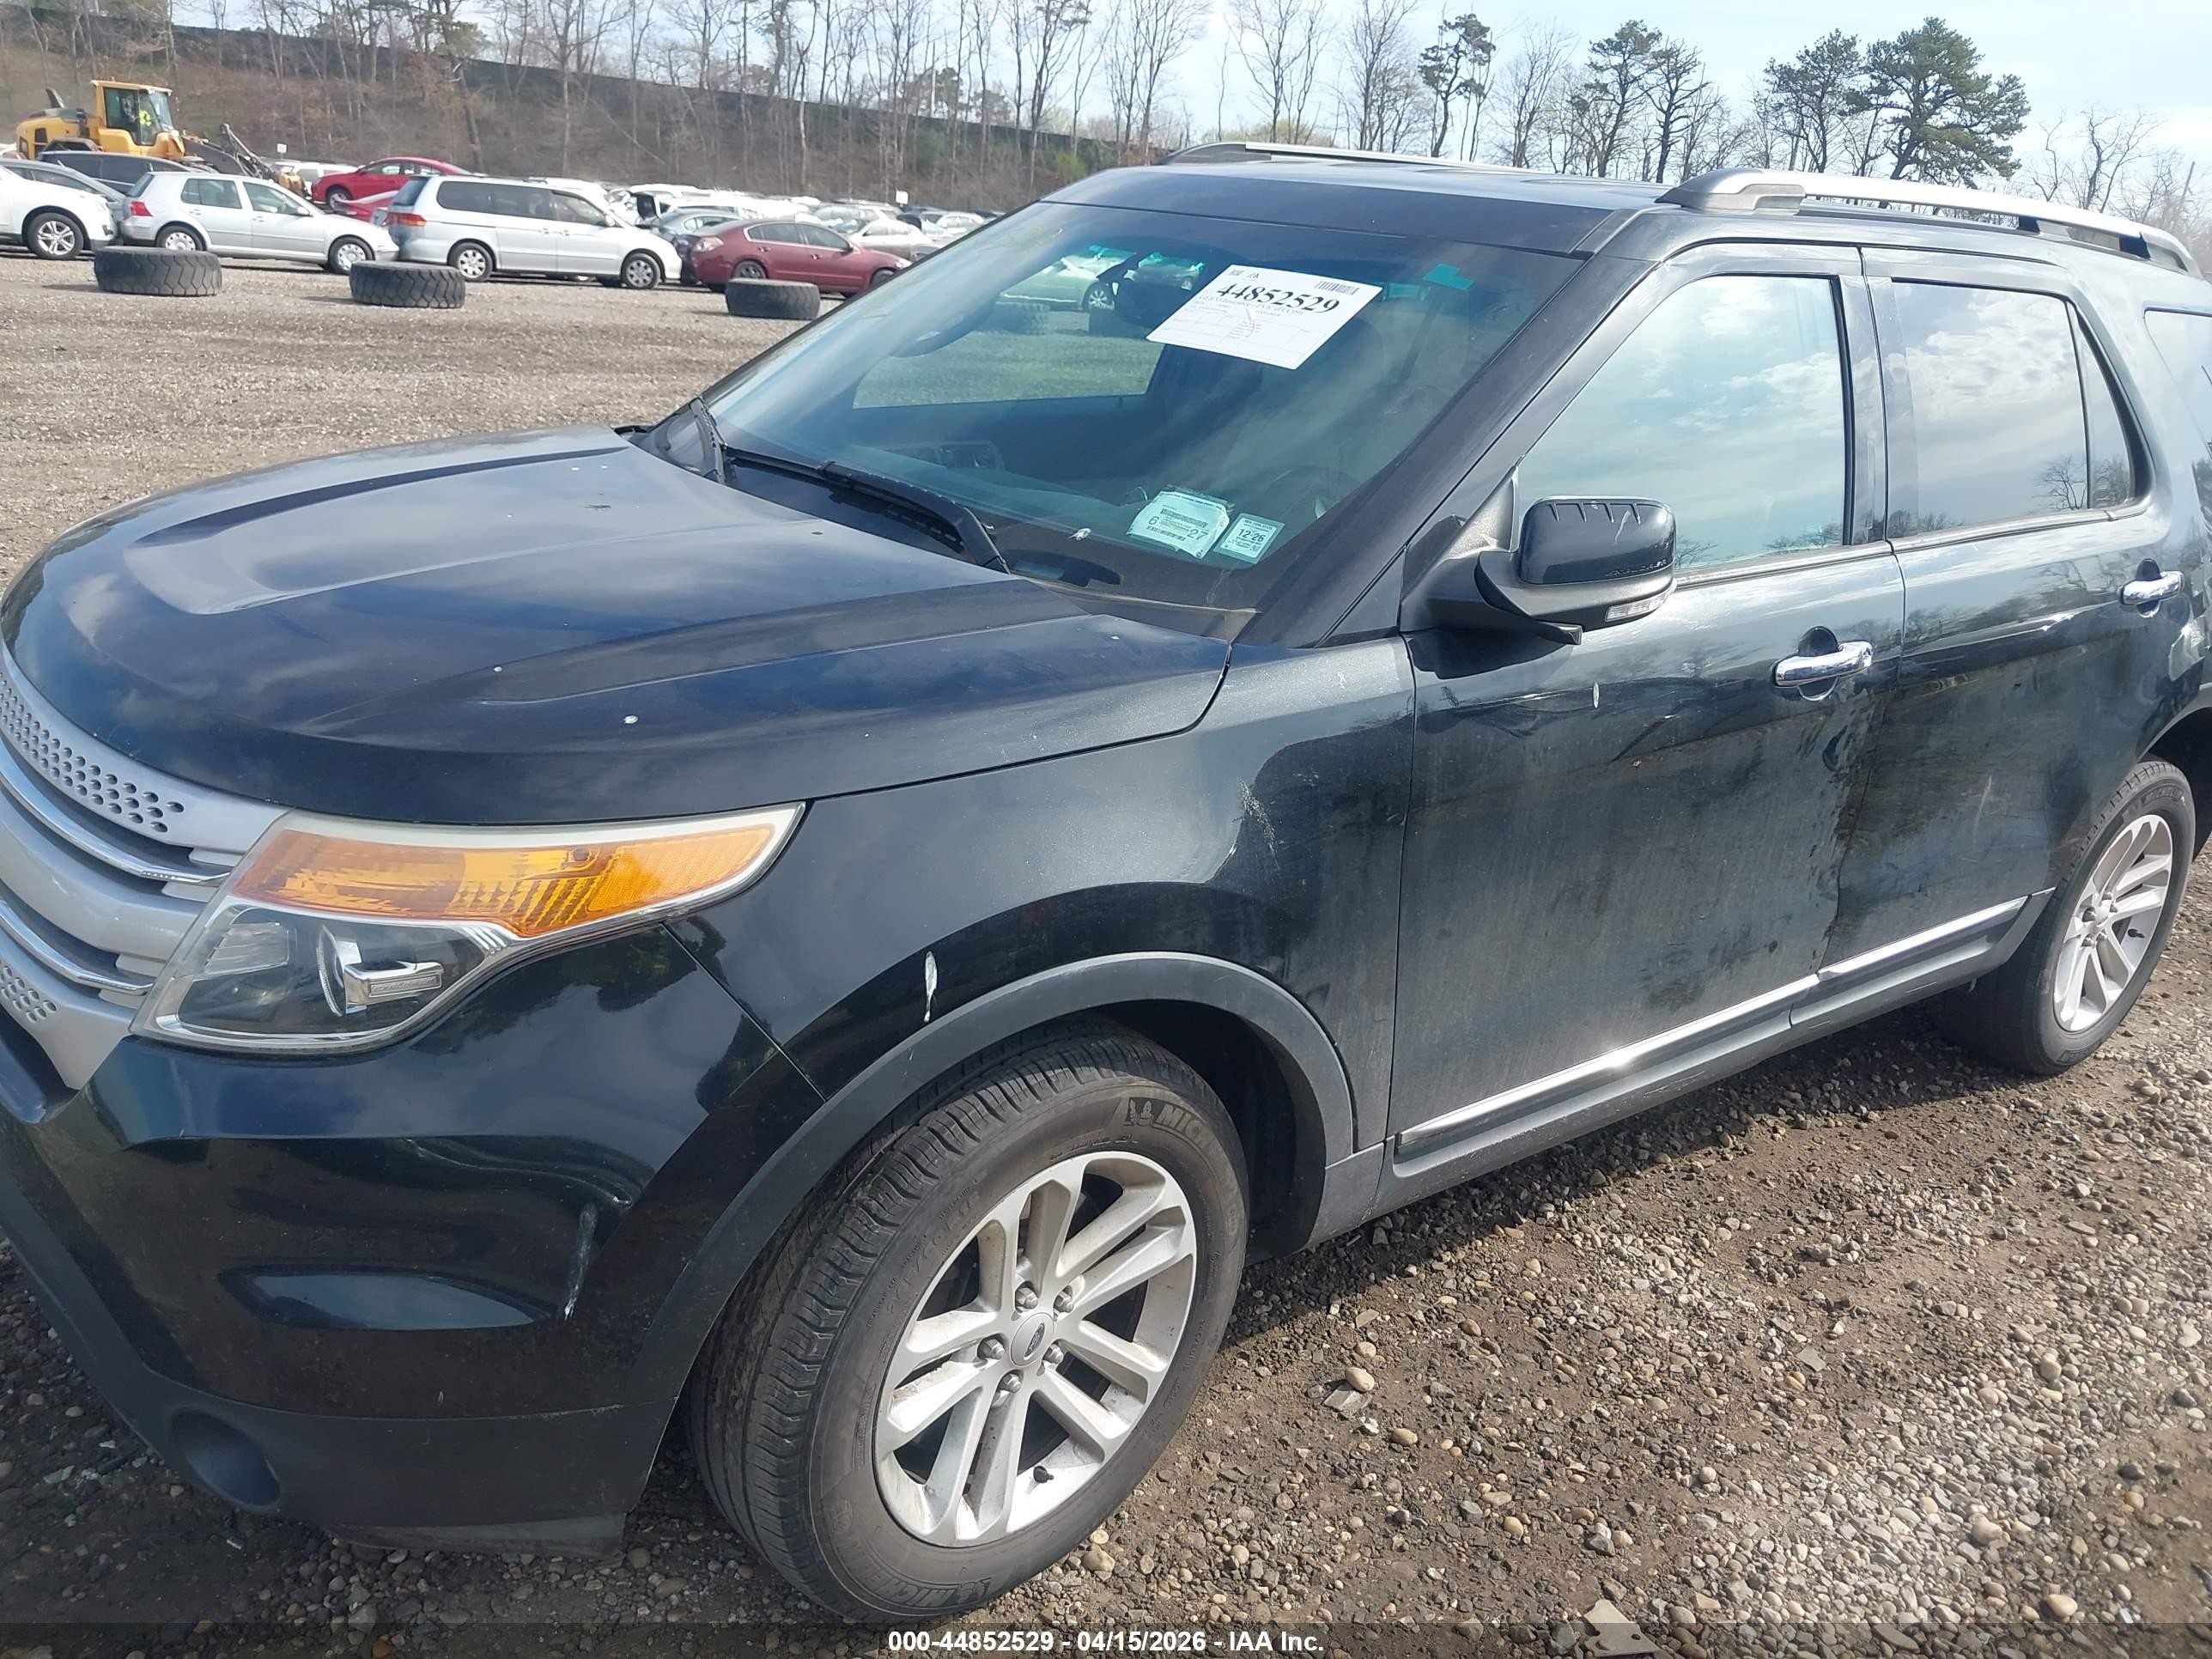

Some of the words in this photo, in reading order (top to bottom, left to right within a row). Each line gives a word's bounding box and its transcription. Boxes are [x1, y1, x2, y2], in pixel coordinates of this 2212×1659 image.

[1216, 283, 1340, 313] 44852529
[1148, 515, 1160, 526] 6
[1187, 528, 1209, 540] 27
[1238, 528, 1267, 543] 12-26
